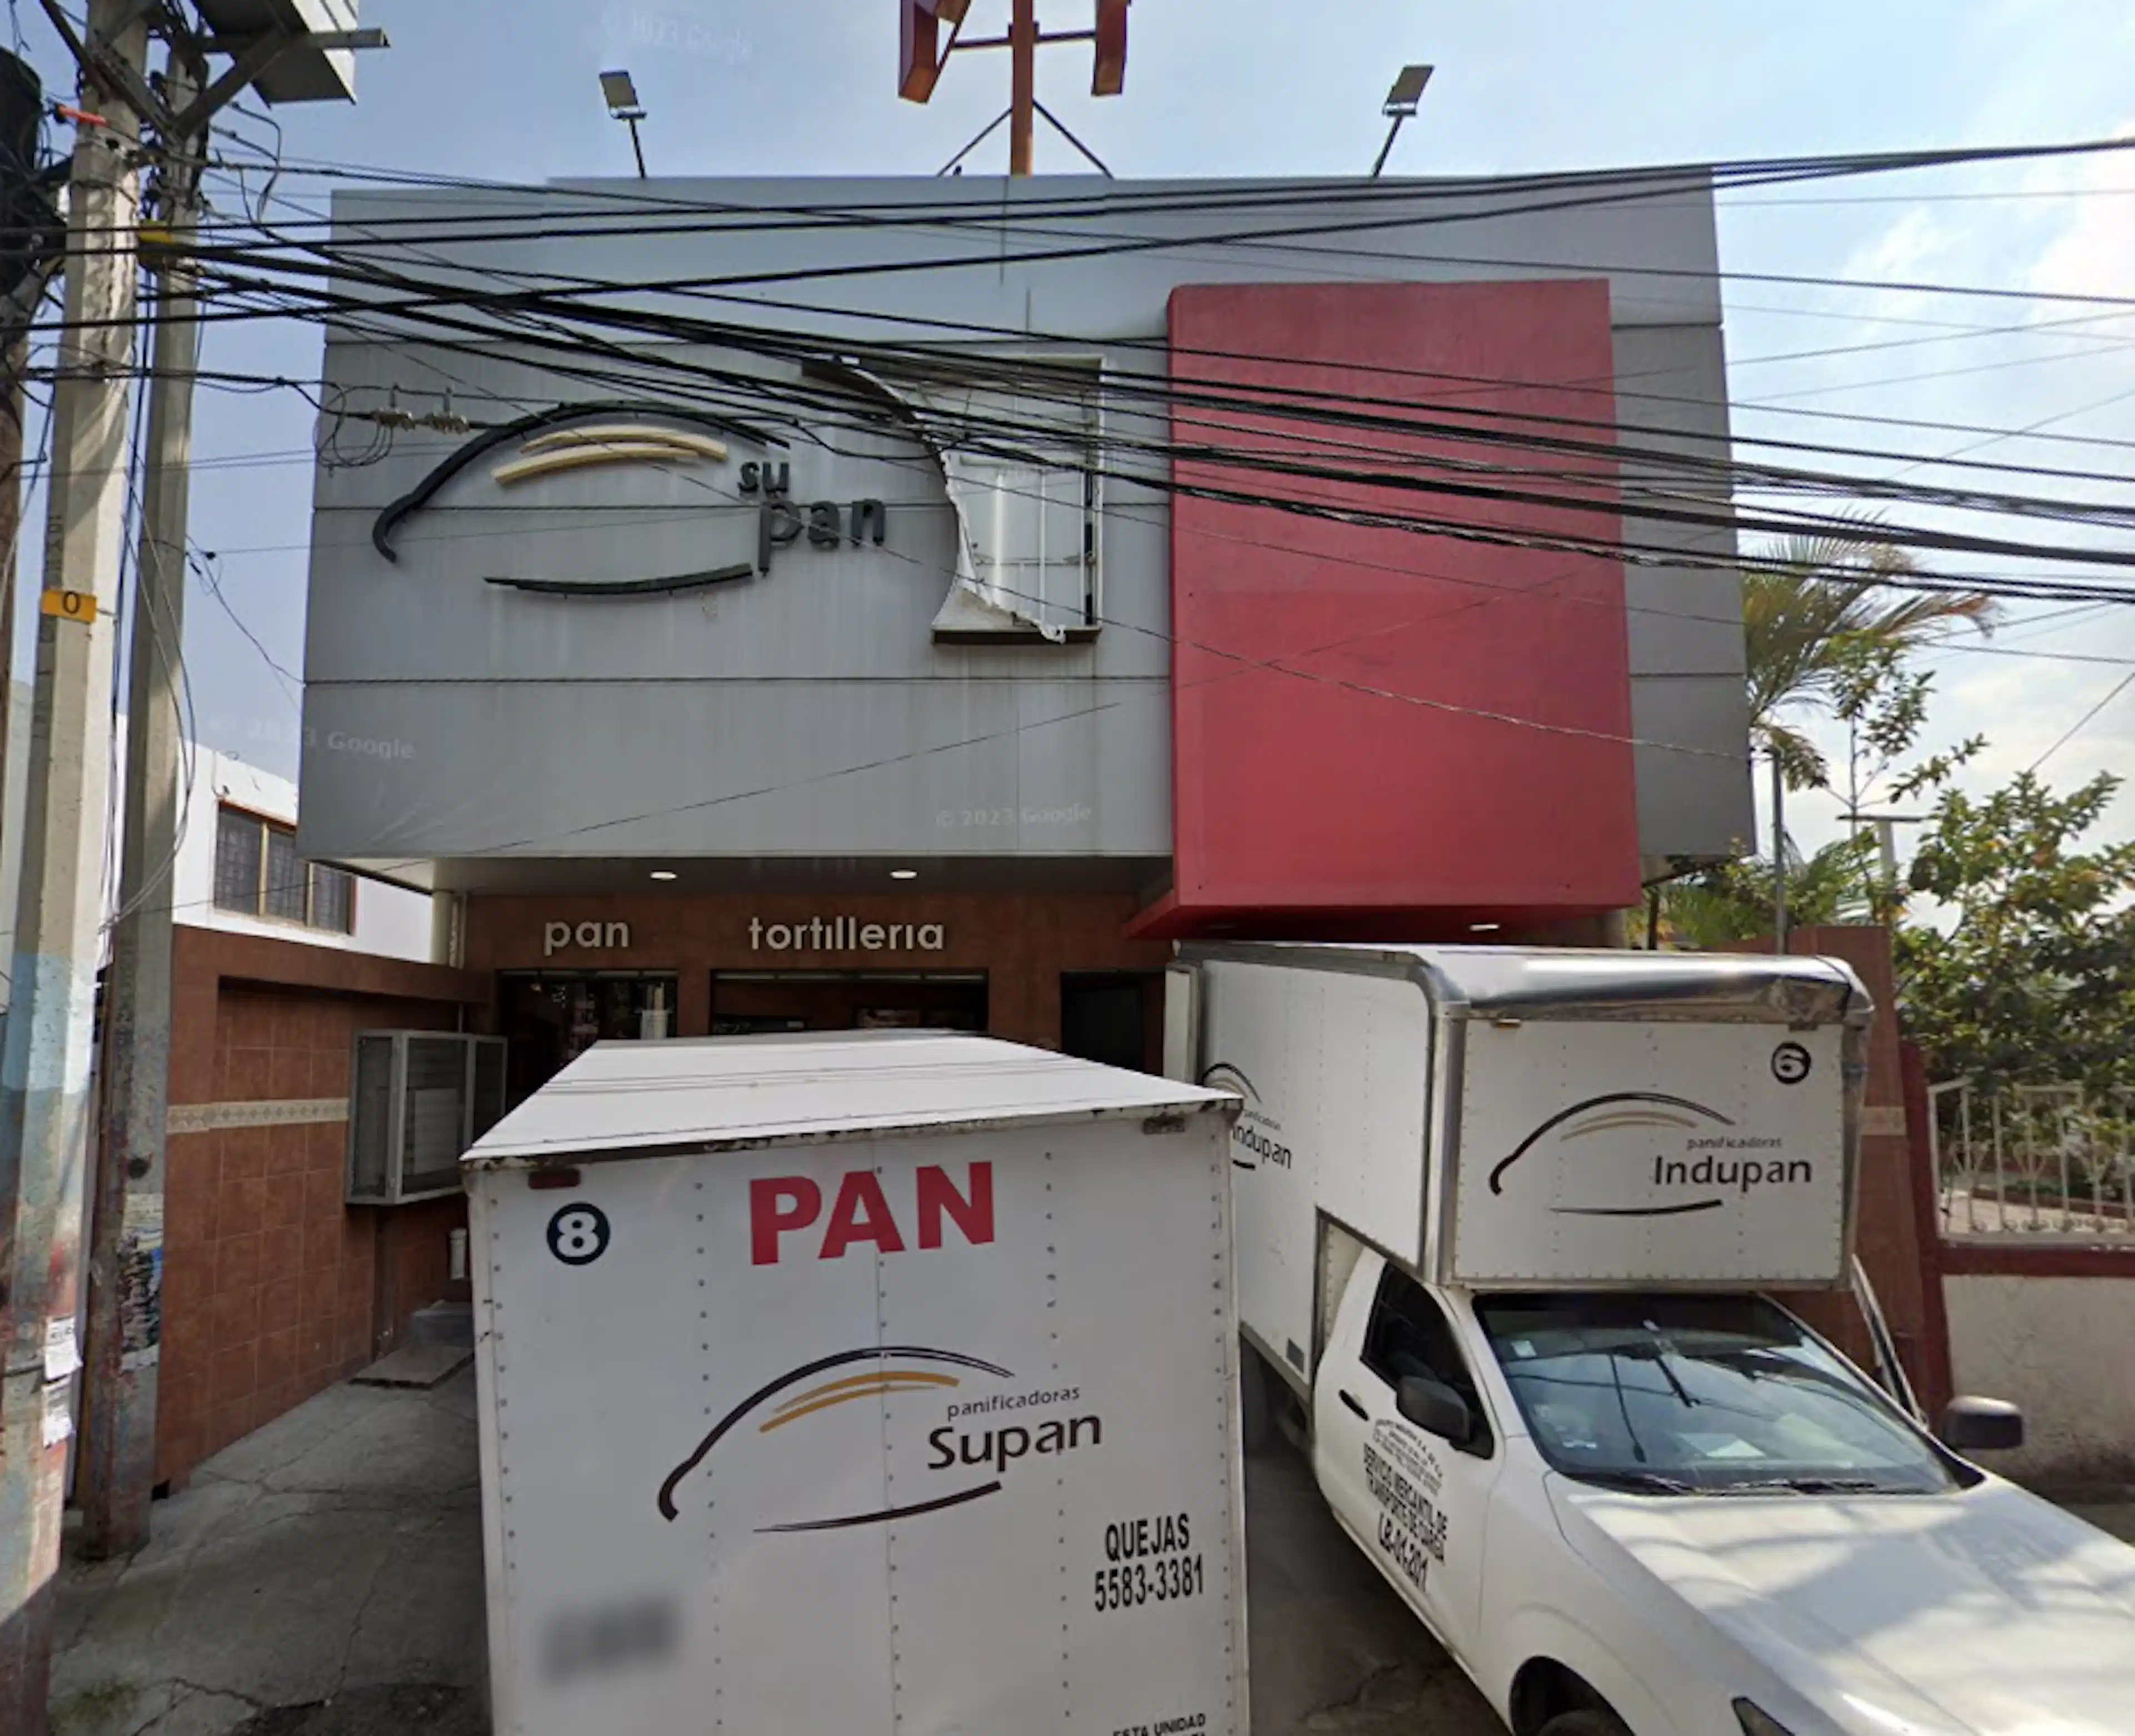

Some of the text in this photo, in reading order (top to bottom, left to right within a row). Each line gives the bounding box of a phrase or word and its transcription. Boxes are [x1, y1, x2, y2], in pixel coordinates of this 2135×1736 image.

[738, 462, 789, 494] su
[758, 499, 886, 578] pan
[544, 921, 629, 956] pan
[748, 916, 944, 951] tortilleria
[1233, 1125, 1292, 1170] ndupan
[1655, 1155, 1811, 1193] Indupan
[555, 1210, 602, 1258] 8
[750, 1161, 994, 1266] PAN
[947, 1386, 1080, 1421] panificadoras
[927, 1414, 1101, 1473] Supan
[1105, 1512, 1190, 1564] QUEJAS
[1094, 1553, 1203, 1612] 5583-3381
